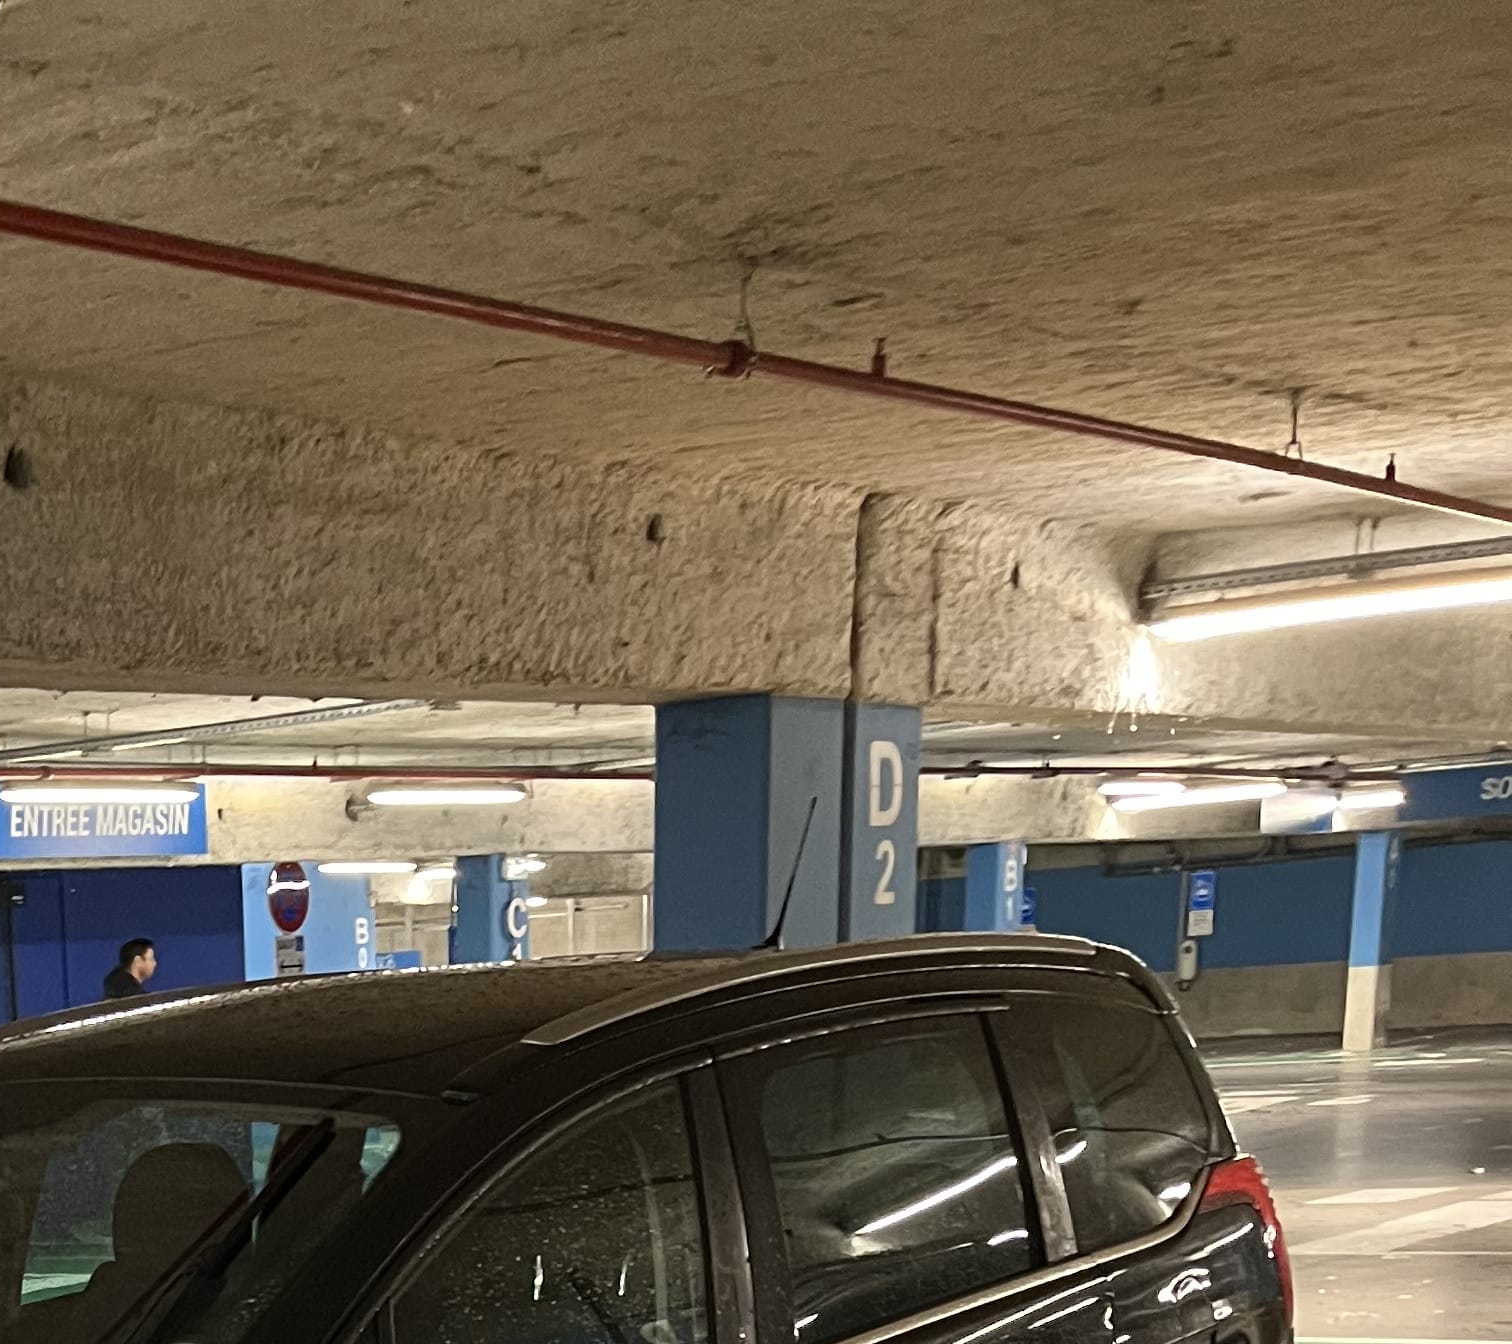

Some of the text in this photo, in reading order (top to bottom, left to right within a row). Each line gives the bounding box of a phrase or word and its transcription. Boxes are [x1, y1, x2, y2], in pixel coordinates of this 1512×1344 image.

[870, 741, 903, 826] D
[10, 803, 190, 837] ENTREE MAGASIN
[874, 840, 896, 905] 2
[355, 917, 369, 944] B
[508, 898, 527, 938] C
